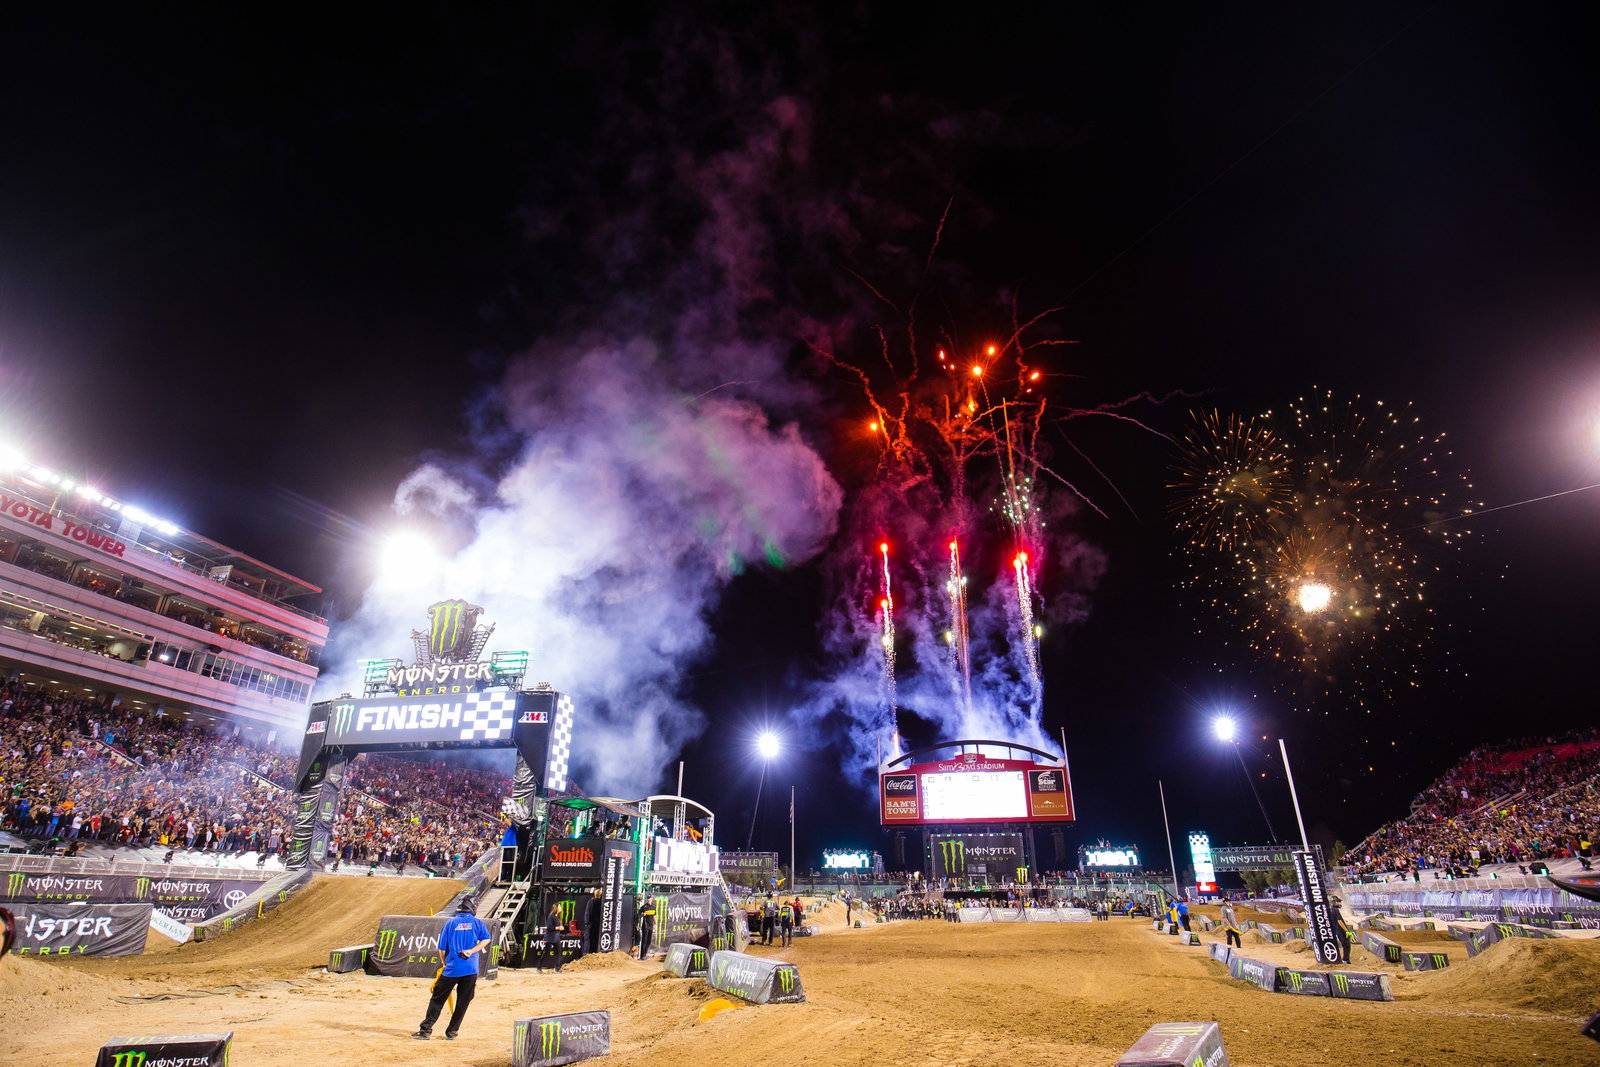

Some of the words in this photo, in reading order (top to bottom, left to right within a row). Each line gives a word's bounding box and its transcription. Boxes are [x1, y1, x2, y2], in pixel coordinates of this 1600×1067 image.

[0, 495, 54, 529] YOTA
[62, 521, 126, 557] TOWER
[386, 662, 492, 686] MONSTER
[399, 684, 474, 697] ENERGY
[356, 703, 462, 732] FINISH
[518, 711, 549, 724] AMA
[938, 763, 954, 772] Sam
[953, 762, 976, 772] Boyd
[886, 800, 917, 808] SAM'S
[886, 807, 917, 815] TOWN
[550, 845, 594, 863] Smith's
[965, 846, 1017, 857] MONSTER
[739, 858, 763, 867] ALLEY
[1220, 854, 1271, 864] MONSTER
[27, 876, 103, 891] MONSTER
[605, 858, 616, 900] HOLESHOT
[1303, 854, 1323, 903] HOLESHOT
[150, 880, 211, 894] MONSTER
[1512, 901, 1554, 915] MONSTER
[602, 901, 610, 932] TOYOTA
[1314, 904, 1329, 941] TOYOTA
[561, 1023, 604, 1036] MONSTER
